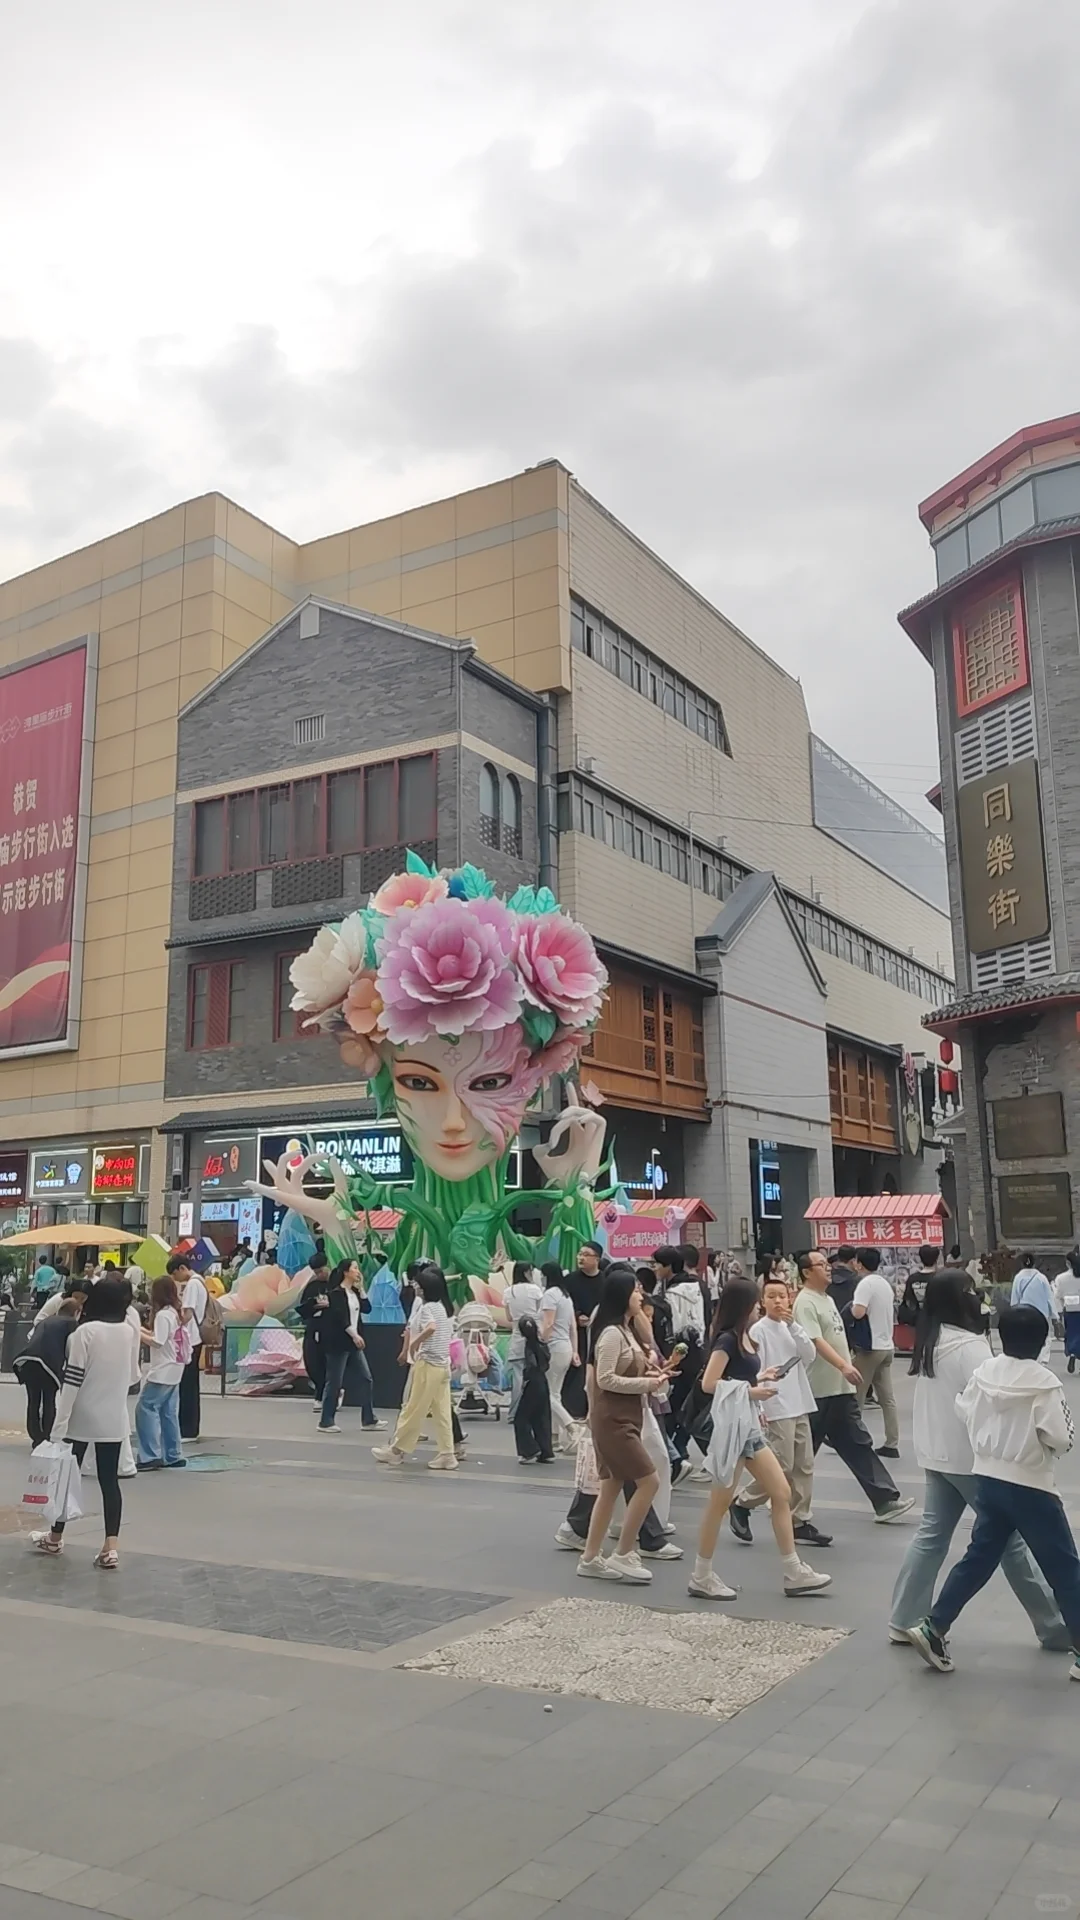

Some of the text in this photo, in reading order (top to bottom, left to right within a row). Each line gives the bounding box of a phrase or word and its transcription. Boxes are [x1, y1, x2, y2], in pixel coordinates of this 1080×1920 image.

[13, 779, 38, 815] 恭贺
[0, 813, 75, 867] 庙步行街入选
[981, 782, 1020, 931] 同樂街
[0, 867, 66, 915] 示范步行街
[819, 1218, 923, 1240] 面部彩绘
